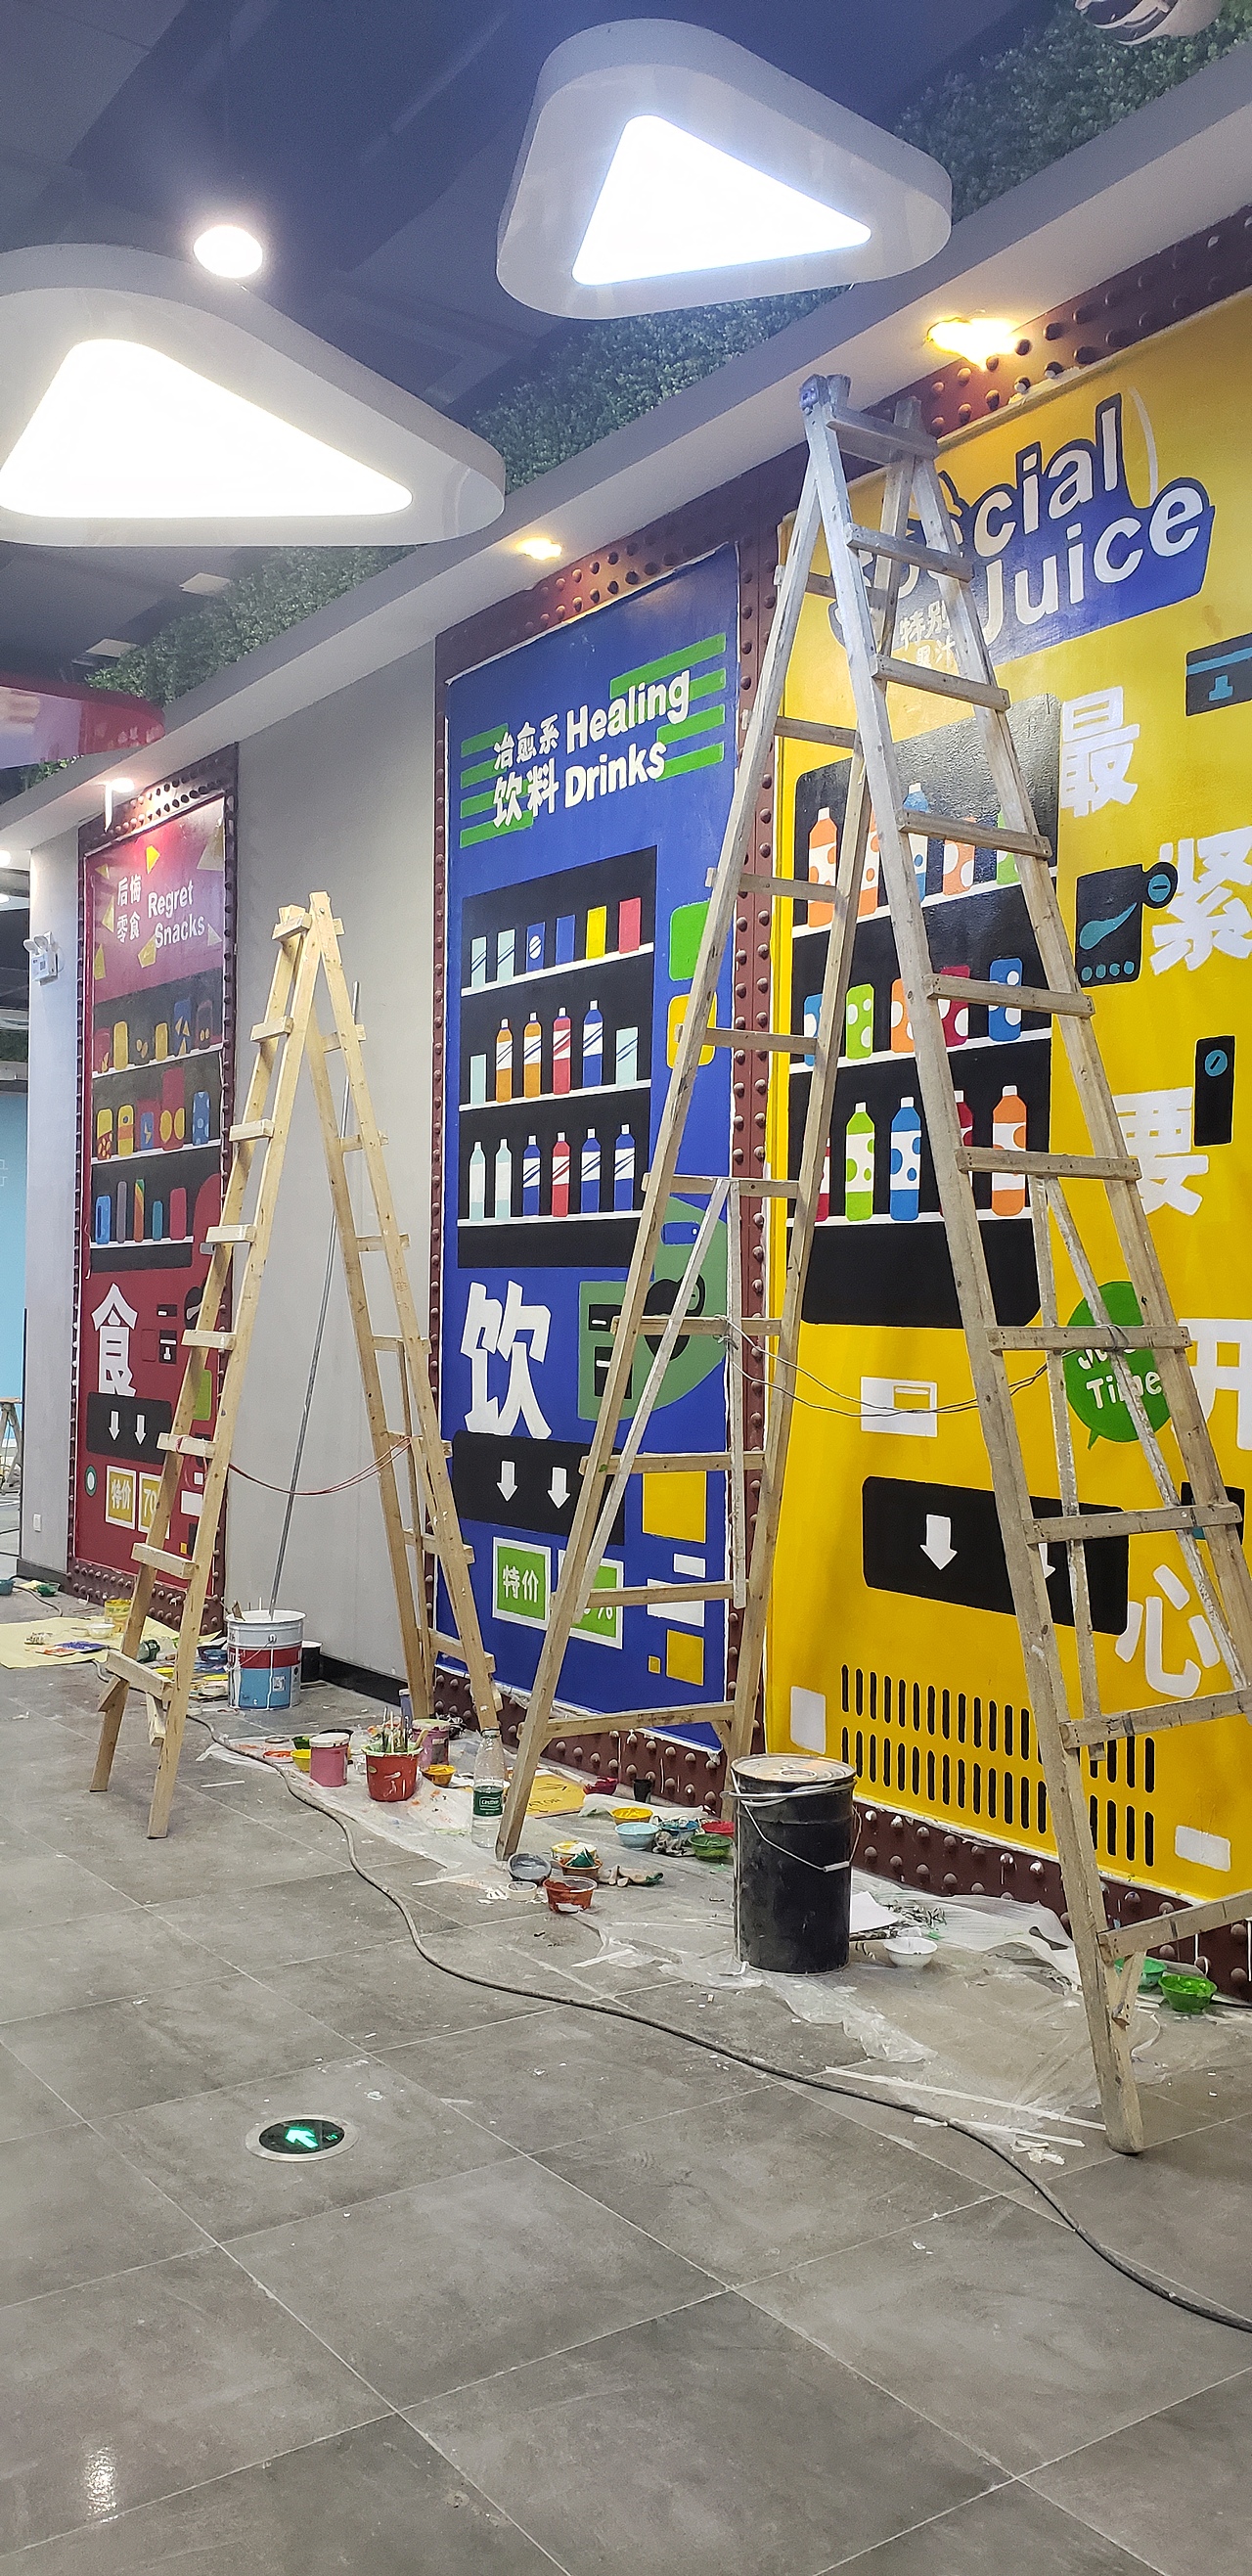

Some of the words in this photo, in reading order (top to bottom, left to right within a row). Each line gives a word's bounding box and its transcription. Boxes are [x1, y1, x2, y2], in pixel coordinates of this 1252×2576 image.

[834, 407, 1122, 651] cial
[981, 486, 1204, 647] Juice
[493, 713, 560, 771] 治愈系
[566, 670, 691, 755] Healing
[492, 757, 560, 829] 饮料
[563, 741, 667, 809] Drinks
[116, 873, 143, 907] 后悔
[148, 880, 194, 919] Regret
[116, 911, 141, 944] 零食
[154, 914, 205, 949] Snacks
[91, 1283, 138, 1397] 食
[460, 1281, 553, 1440] 饮
[502, 1564, 540, 1604] 特价
